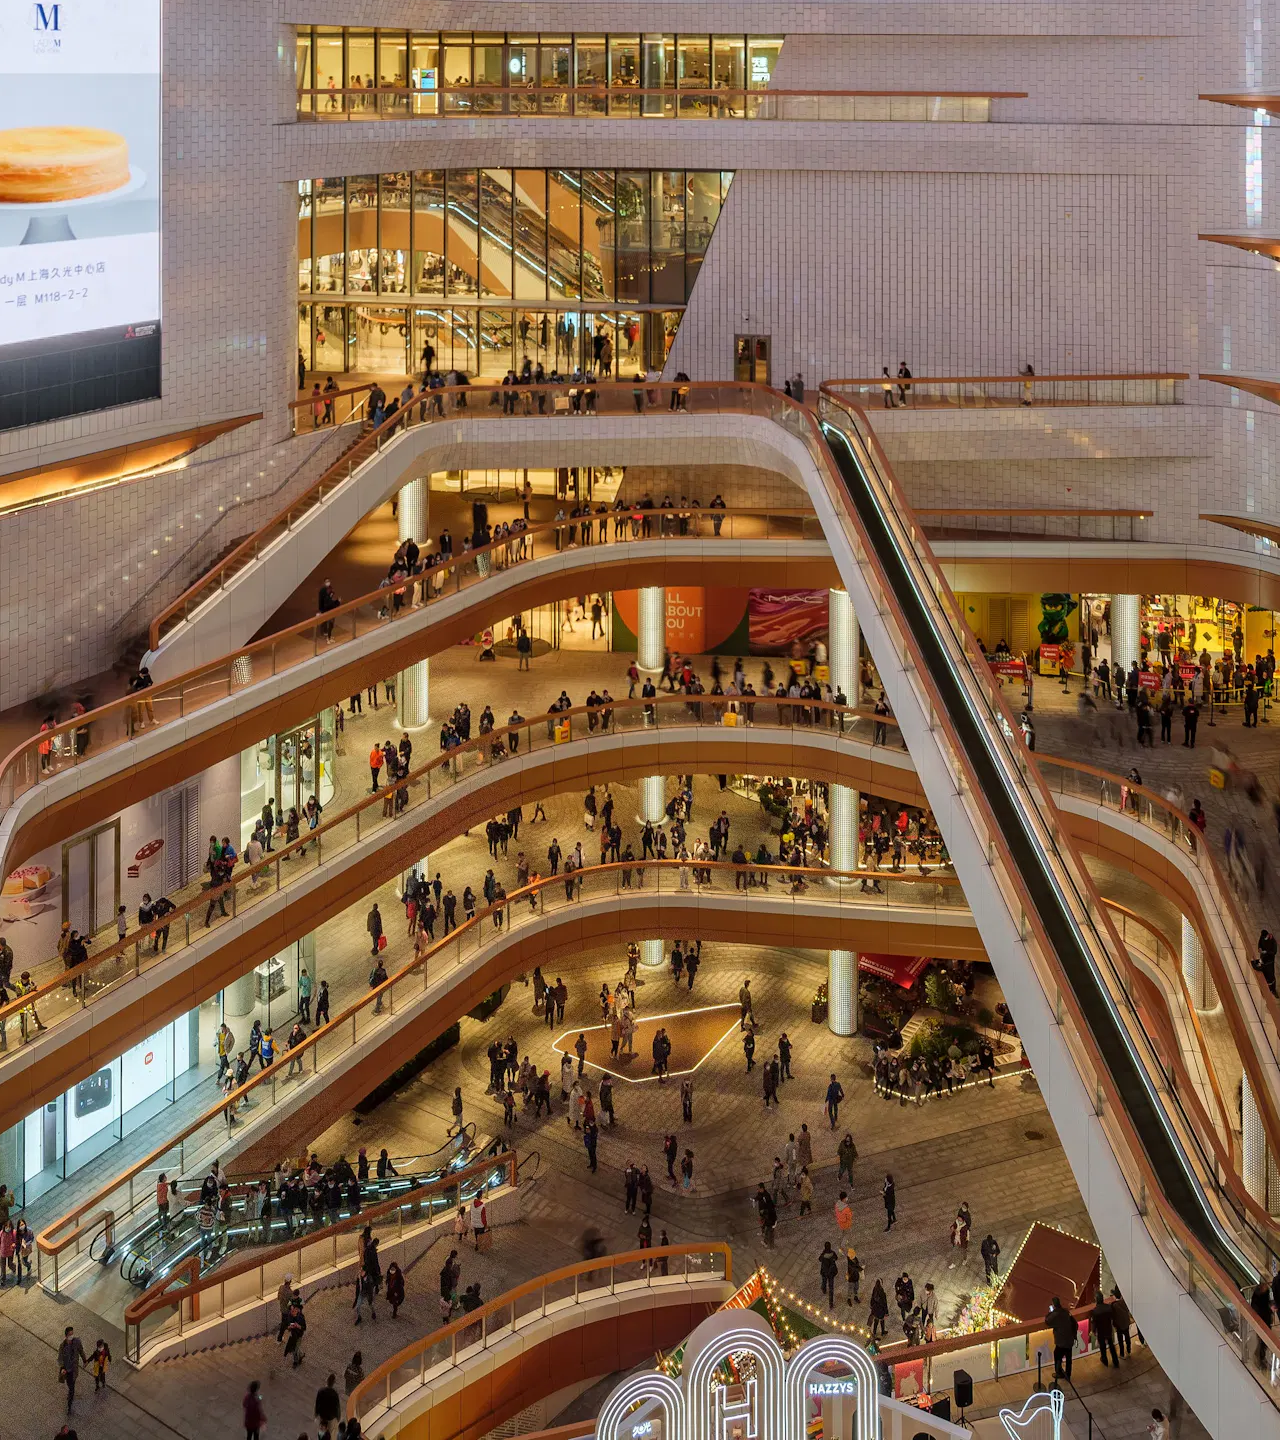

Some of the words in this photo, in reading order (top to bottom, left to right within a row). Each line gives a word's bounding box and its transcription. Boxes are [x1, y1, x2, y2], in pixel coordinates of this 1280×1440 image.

[33, 3, 61, 31] M
[28, 262, 105, 281] 上海久光中心店
[5, 295, 27, 307] 一层
[35, 288, 88, 304] M118-2-2
[665, 593, 684, 604] LL
[665, 606, 703, 618] BOUT
[666, 618, 685, 629] OU
[809, 1381, 854, 1395] HAZZYS
